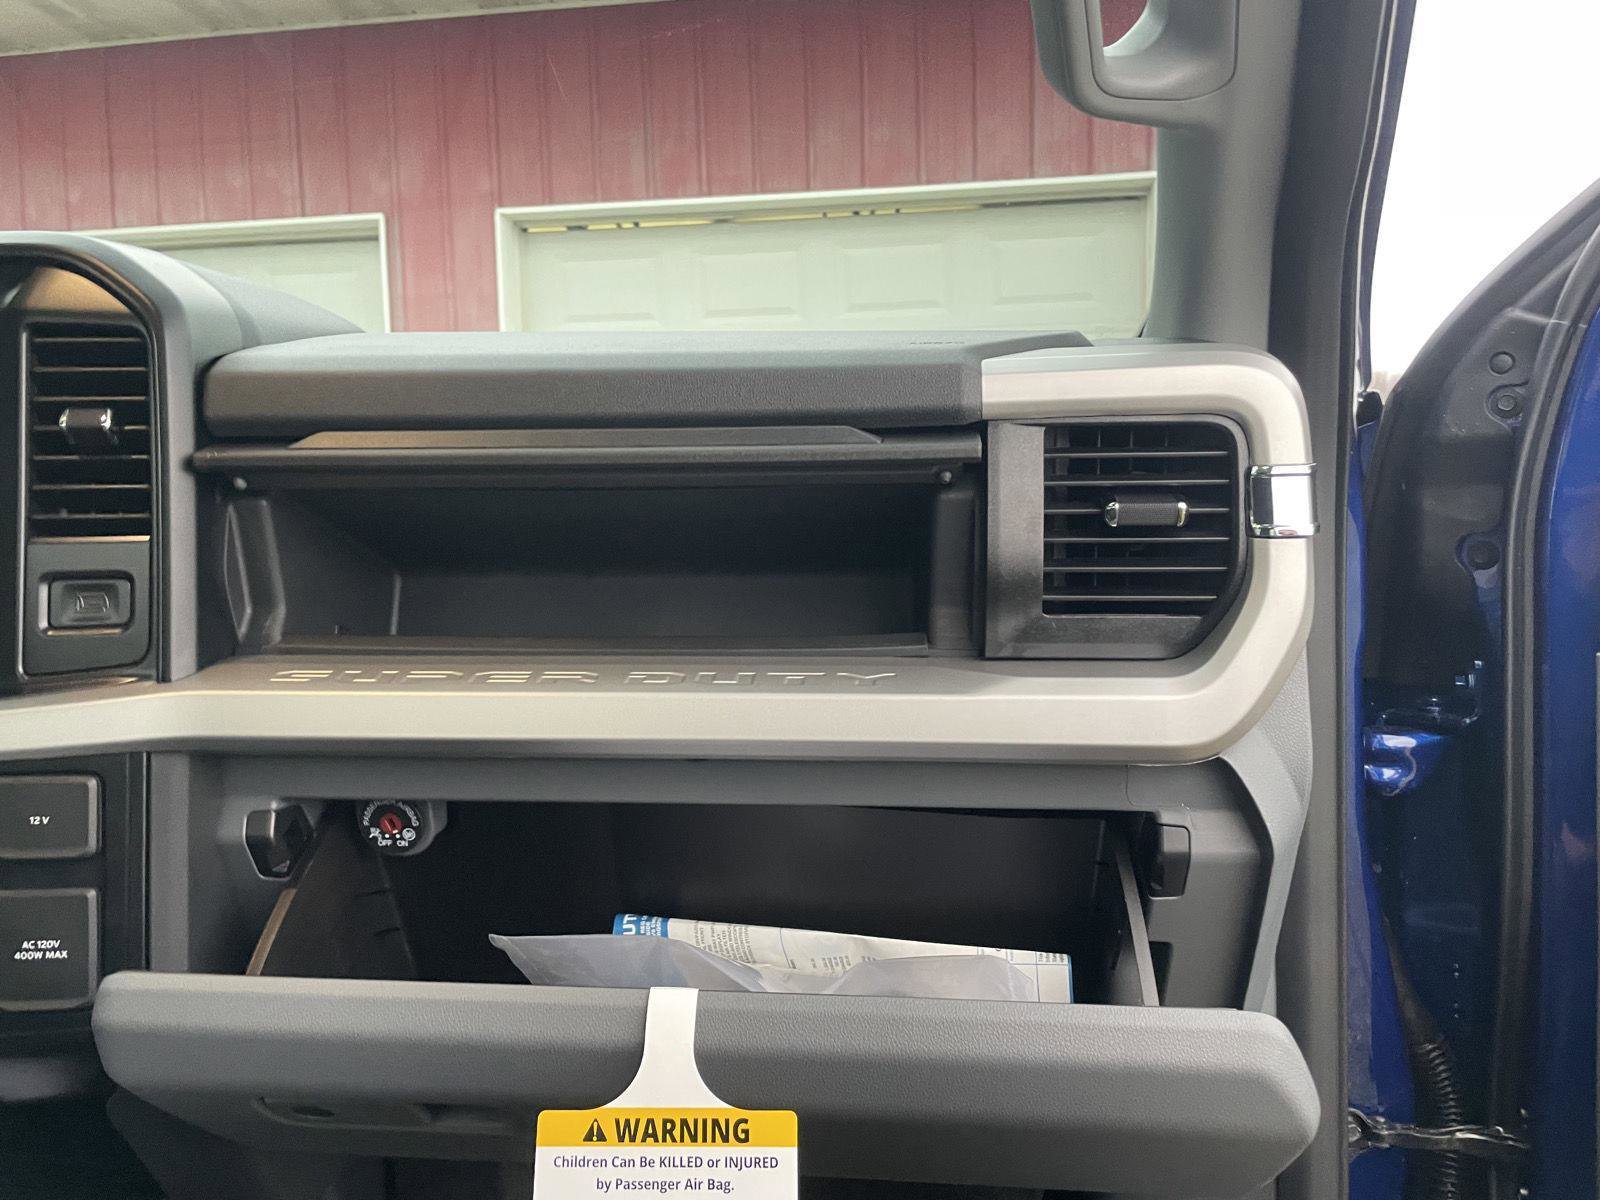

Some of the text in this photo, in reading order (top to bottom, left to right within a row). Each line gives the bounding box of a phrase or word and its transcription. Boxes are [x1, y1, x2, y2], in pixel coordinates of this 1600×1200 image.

[268, 669, 897, 685] SUPER DUTY
[29, 816, 50, 825] 12 V
[377, 839, 409, 847] OFF ON
[21, 939, 61, 949] AC 120V
[14, 950, 68, 960] 400W MAX
[614, 1117, 750, 1144] WARNING
[553, 1155, 779, 1171] Children Can Be KILLED or INJURED
[596, 1178, 735, 1193] by Passenger Air Bag.
